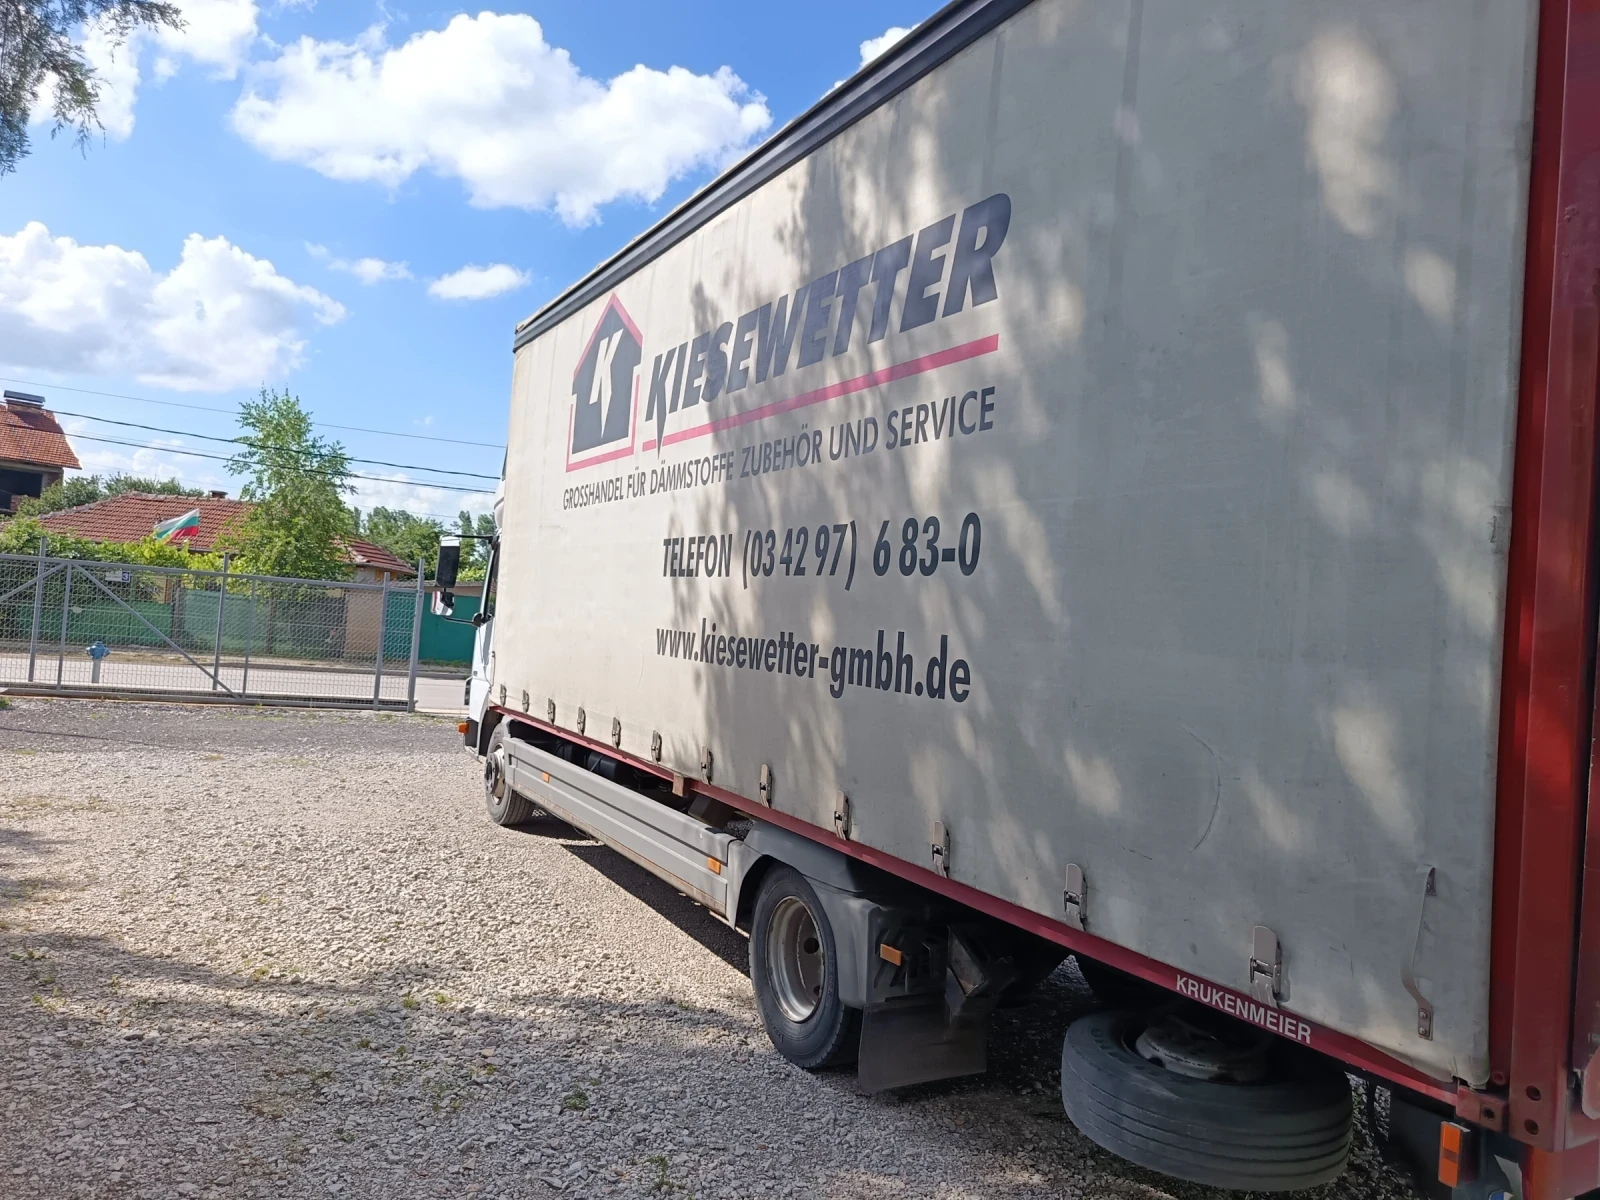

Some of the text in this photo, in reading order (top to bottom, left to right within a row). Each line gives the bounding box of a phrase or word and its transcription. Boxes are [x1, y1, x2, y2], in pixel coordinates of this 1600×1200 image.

[645, 193, 1012, 459] KIESEWETTER
[588, 328, 625, 440] K
[563, 386, 995, 510] GROSSHANDEL FÜR DÄMMSTOFFE ZUBEHÖR UND SERVICE
[662, 534, 733, 577] TELEFON
[656, 618, 971, 703] www.kiesewetter-gmbh.de
[1176, 974, 1311, 1044] KRUKENMEIER
